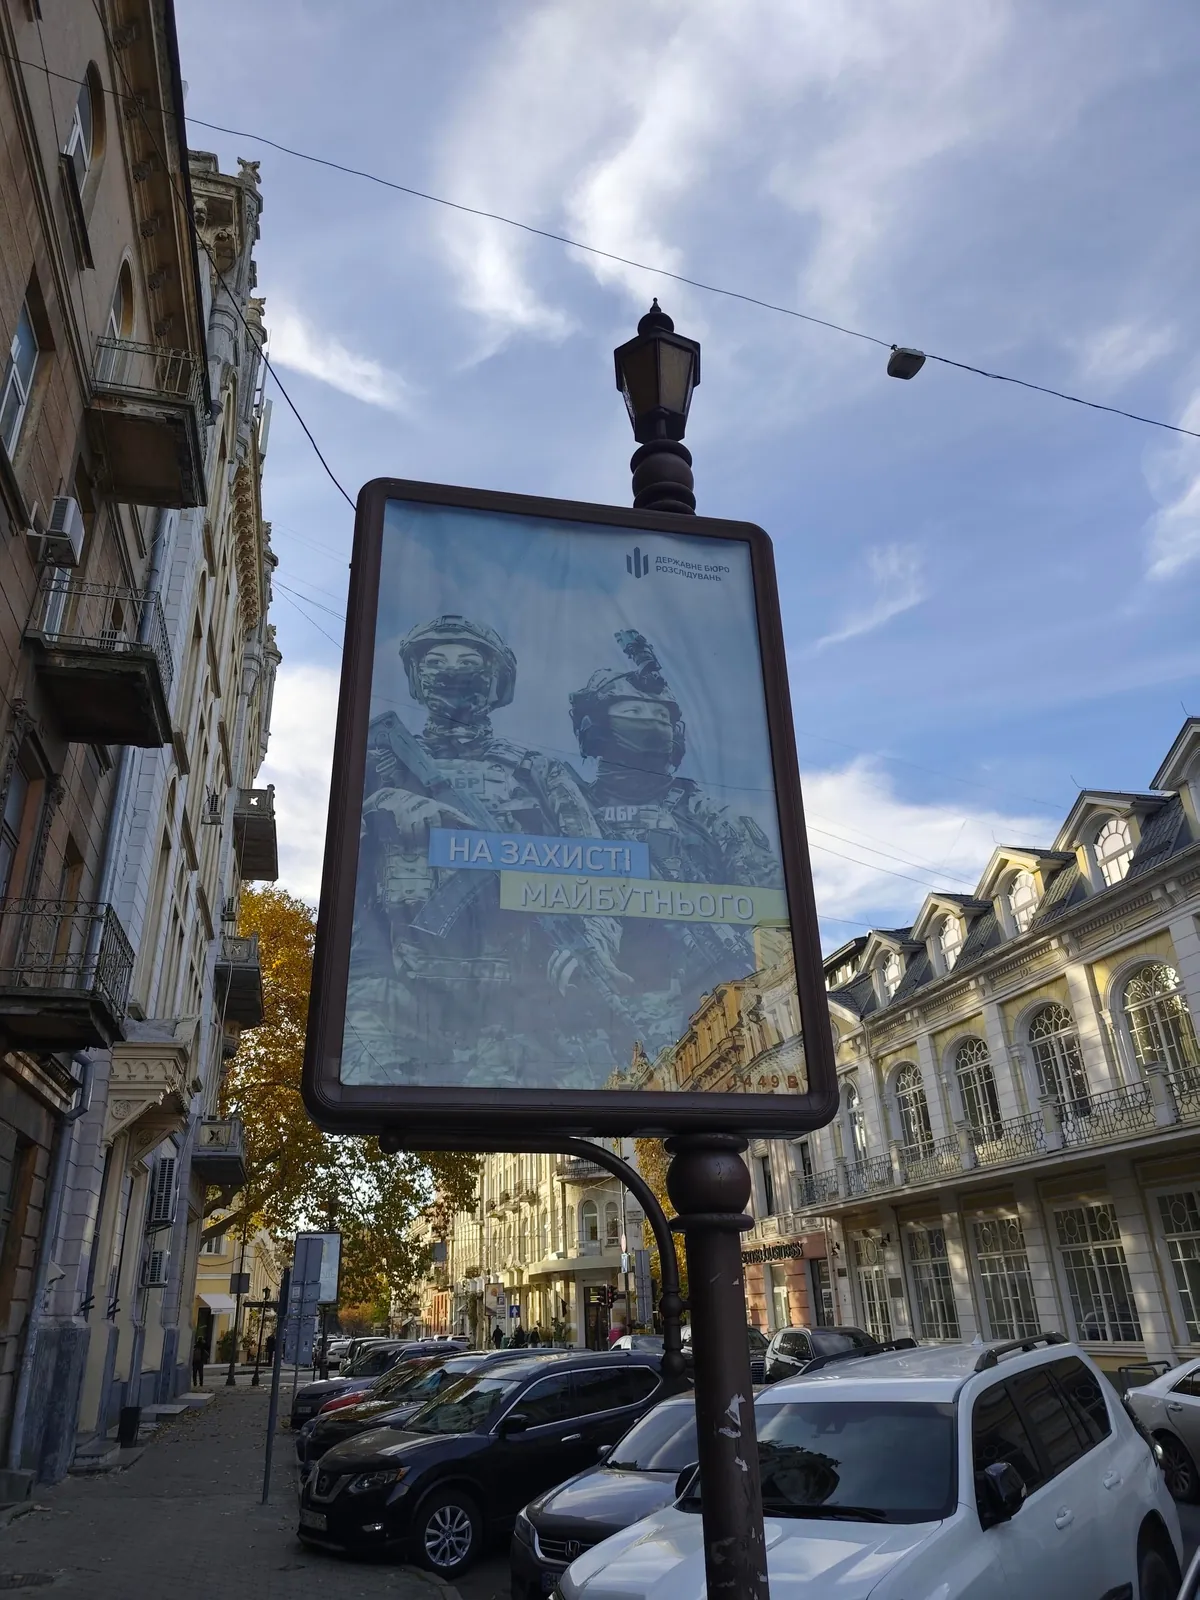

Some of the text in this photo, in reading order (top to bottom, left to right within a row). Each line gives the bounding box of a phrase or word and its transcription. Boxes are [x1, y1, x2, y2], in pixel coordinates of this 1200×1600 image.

[655, 556, 729, 573] ДЕРЖАВНЕ БЮРО
[655, 565, 722, 581] РОЗСЛІДУВАНЬ
[448, 777, 480, 789] БР
[604, 806, 638, 821] ДБР
[449, 837, 631, 872] НА ЗАХИСТІ
[521, 878, 754, 920] МАЙБУТНЬОГО
